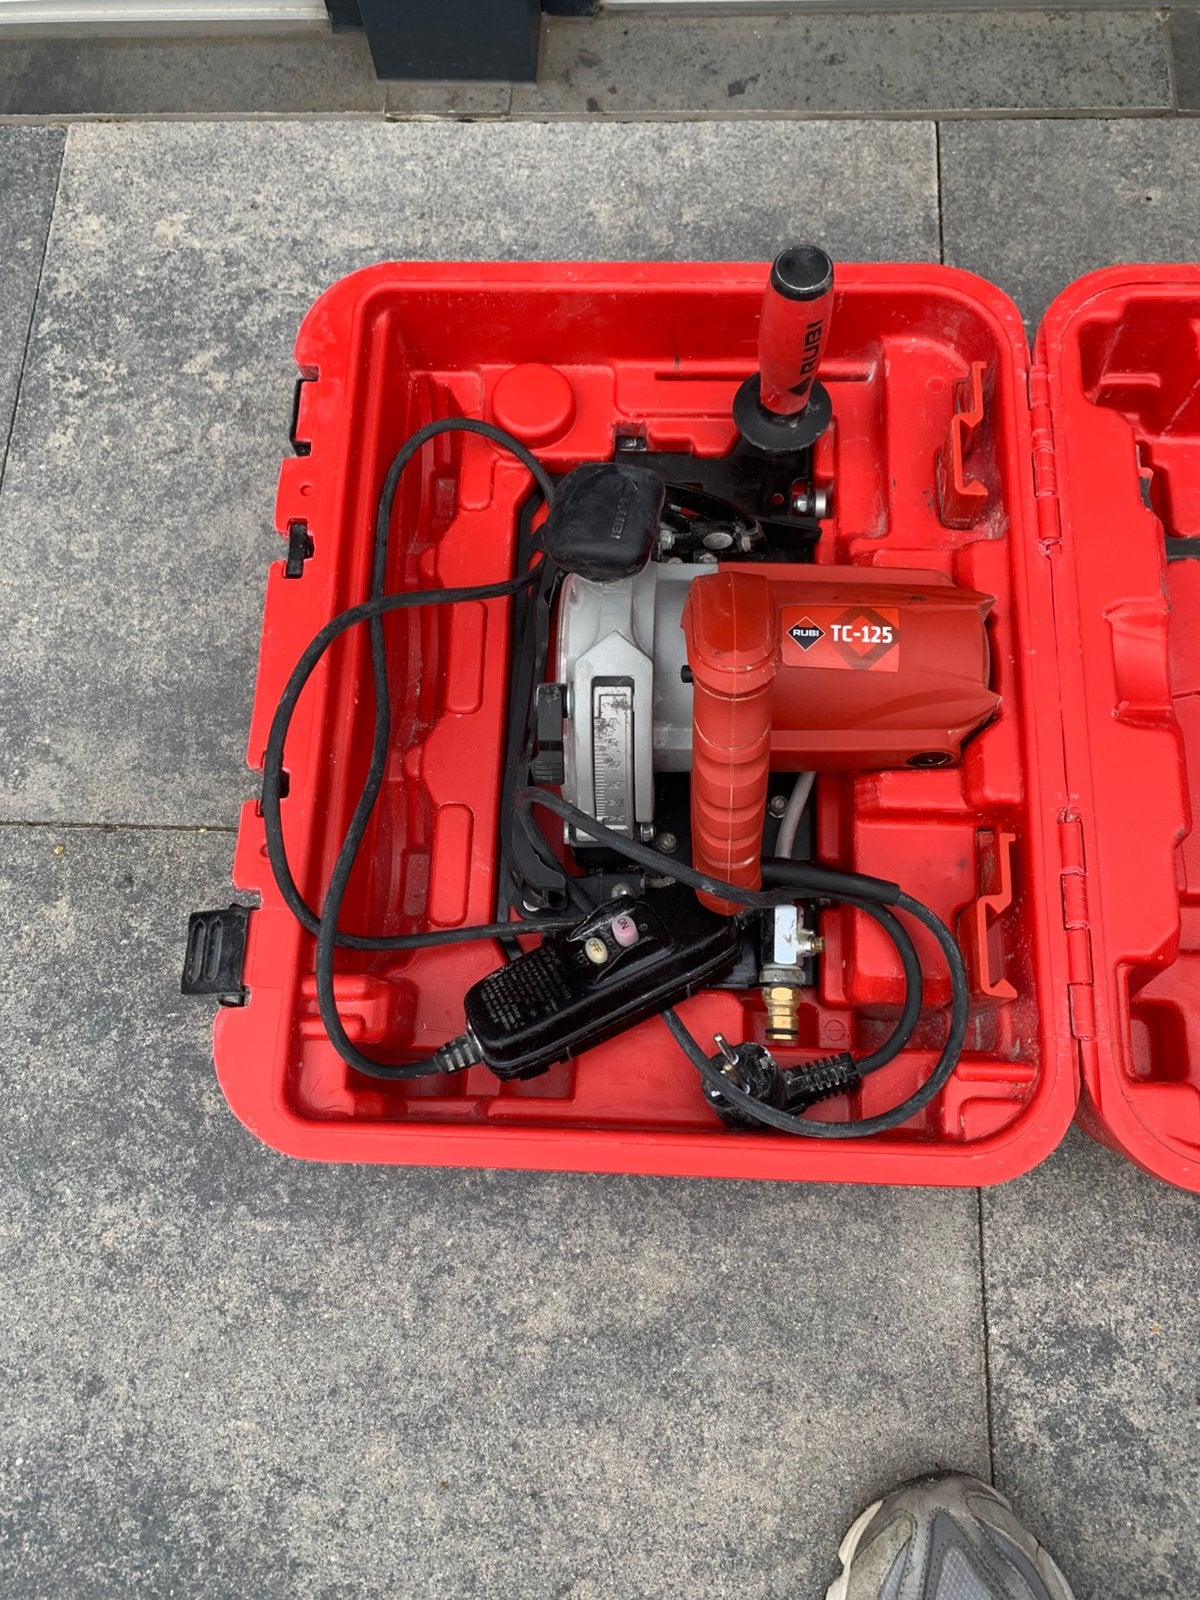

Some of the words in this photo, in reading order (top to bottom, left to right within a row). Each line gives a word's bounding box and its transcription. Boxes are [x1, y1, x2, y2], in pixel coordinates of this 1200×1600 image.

[800, 319, 823, 375] RUBI
[792, 628, 820, 637] RUBI
[830, 624, 893, 643] TC-125
[617, 917, 631, 930] ON
[588, 939, 603, 953] OFF
